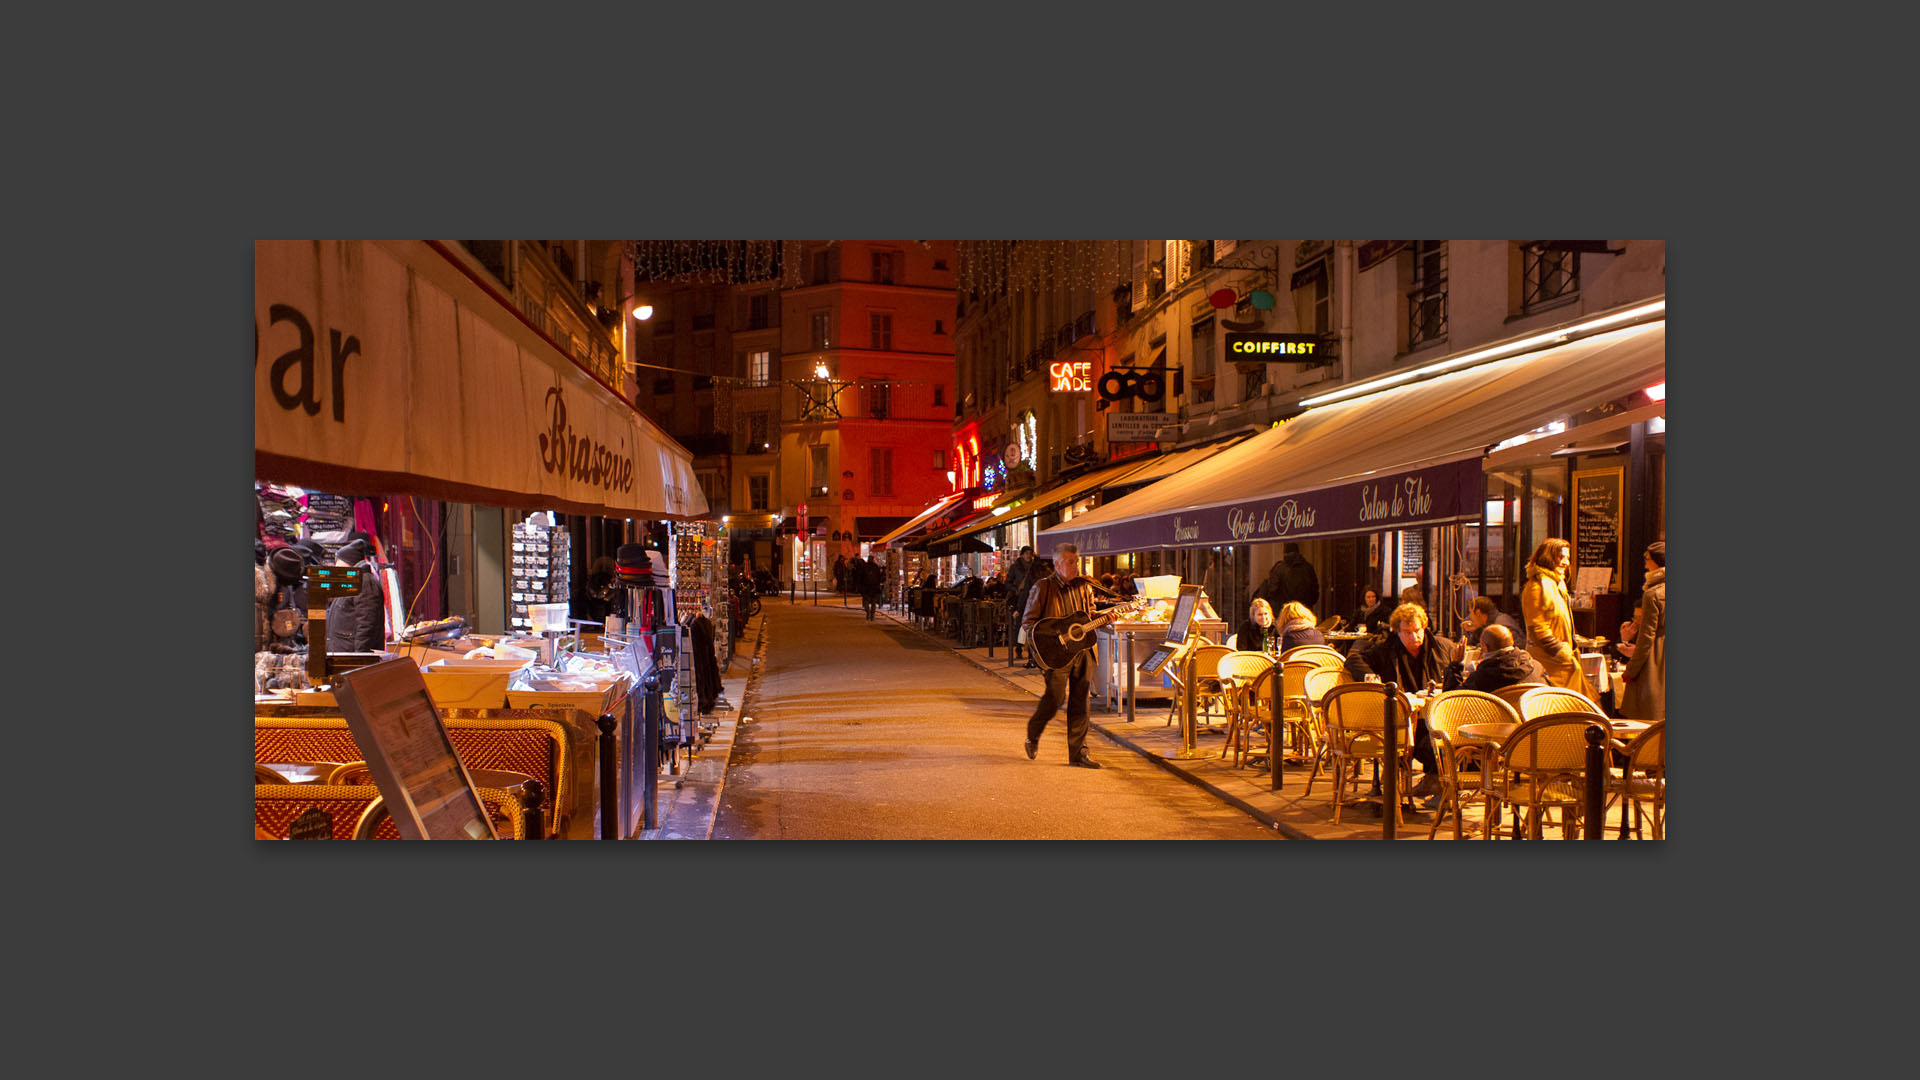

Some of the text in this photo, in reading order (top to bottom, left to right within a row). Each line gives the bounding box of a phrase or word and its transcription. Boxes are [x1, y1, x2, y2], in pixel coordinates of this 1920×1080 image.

[255, 303, 361, 423] ar
[1050, 362, 1092, 378] CAFE
[1052, 377, 1092, 391] JADE
[539, 387, 634, 494] Brasserie
[1227, 499, 1316, 543] Café de Paris
[1359, 476, 1433, 522] Salon de Thé
